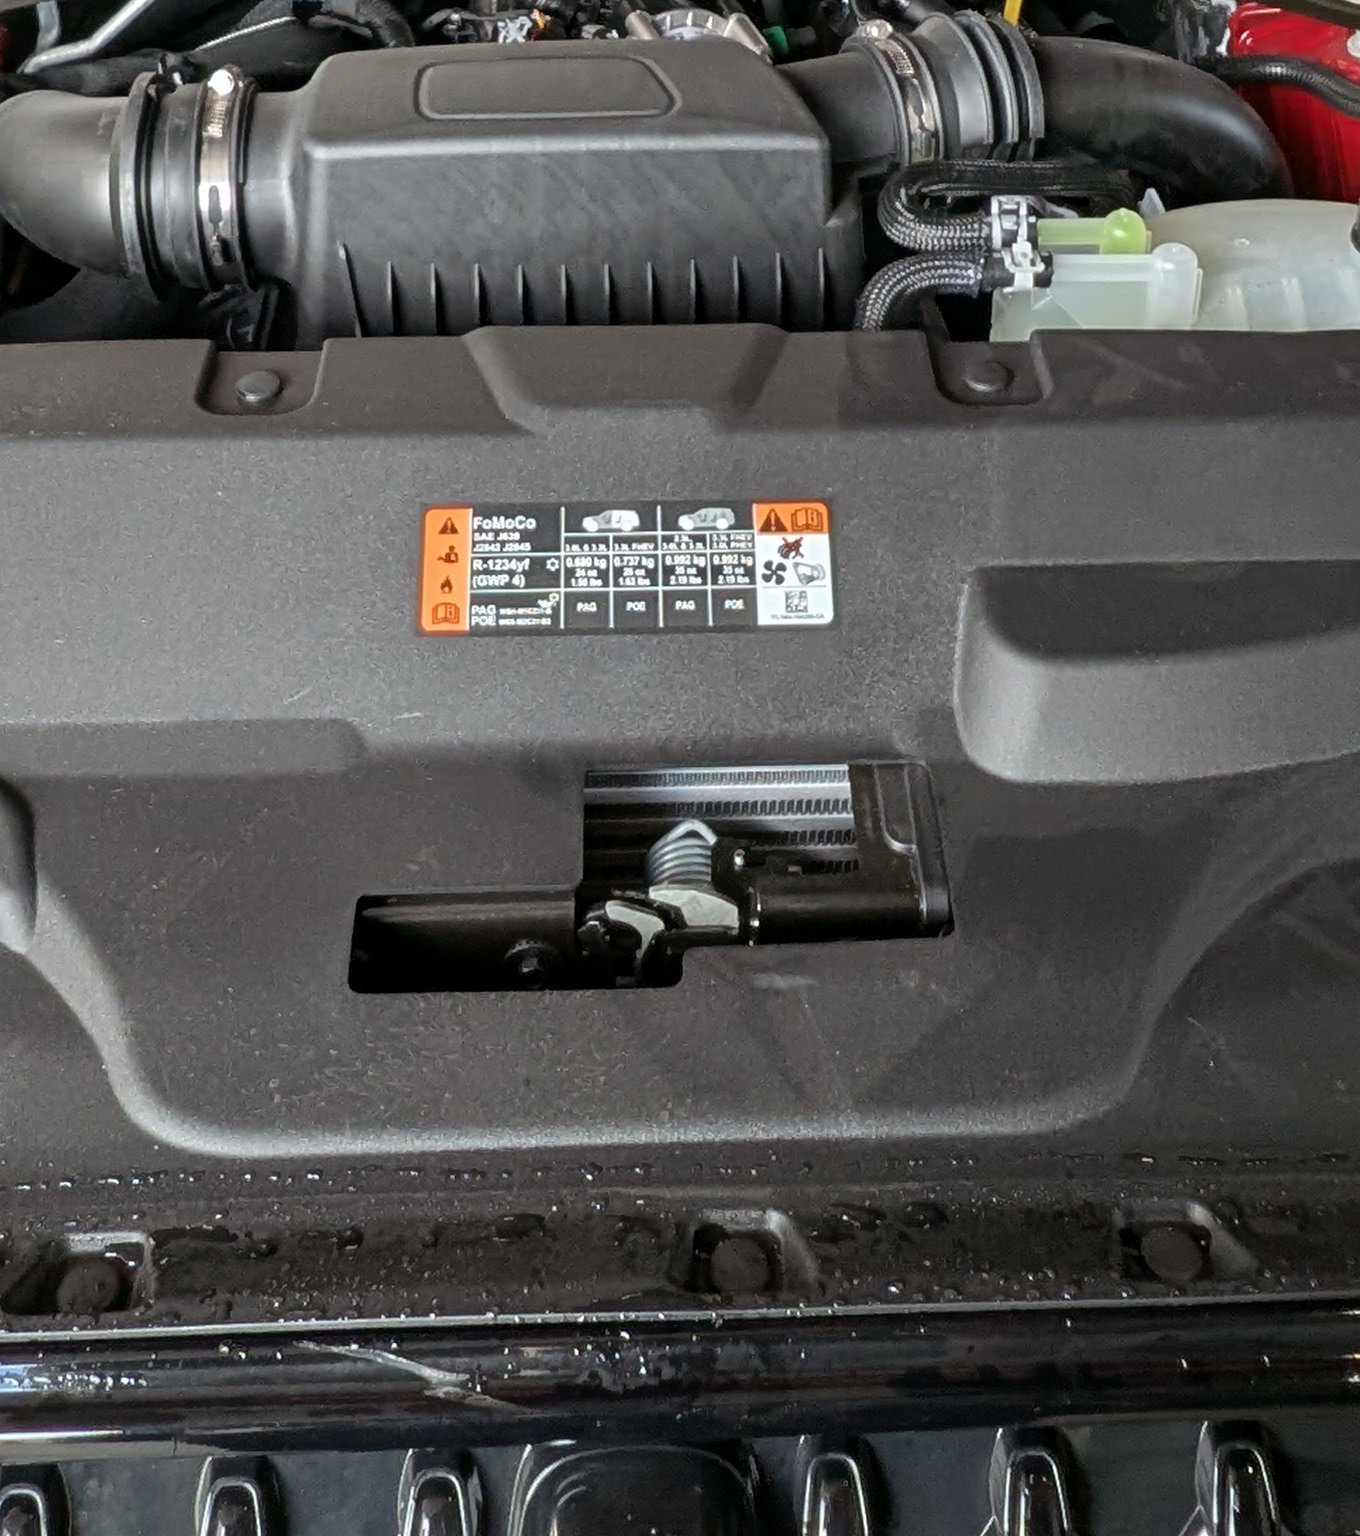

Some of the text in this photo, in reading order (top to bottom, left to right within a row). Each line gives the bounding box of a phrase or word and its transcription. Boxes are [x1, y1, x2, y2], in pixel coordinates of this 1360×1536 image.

[473, 515, 537, 530] FoMoCo
[472, 558, 531, 572] R-1234yf
[593, 556, 607, 569] kg
[641, 555, 655, 569] kg
[692, 554, 706, 567] kg
[740, 554, 753, 566] kg
[472, 574, 526, 588] (GWP 4)
[471, 604, 497, 615] PAG
[576, 601, 597, 613] PAG
[626, 601, 646, 611] POE
[674, 600, 696, 611] PAG
[723, 599, 745, 610] POE
[471, 615, 497, 626] POE
